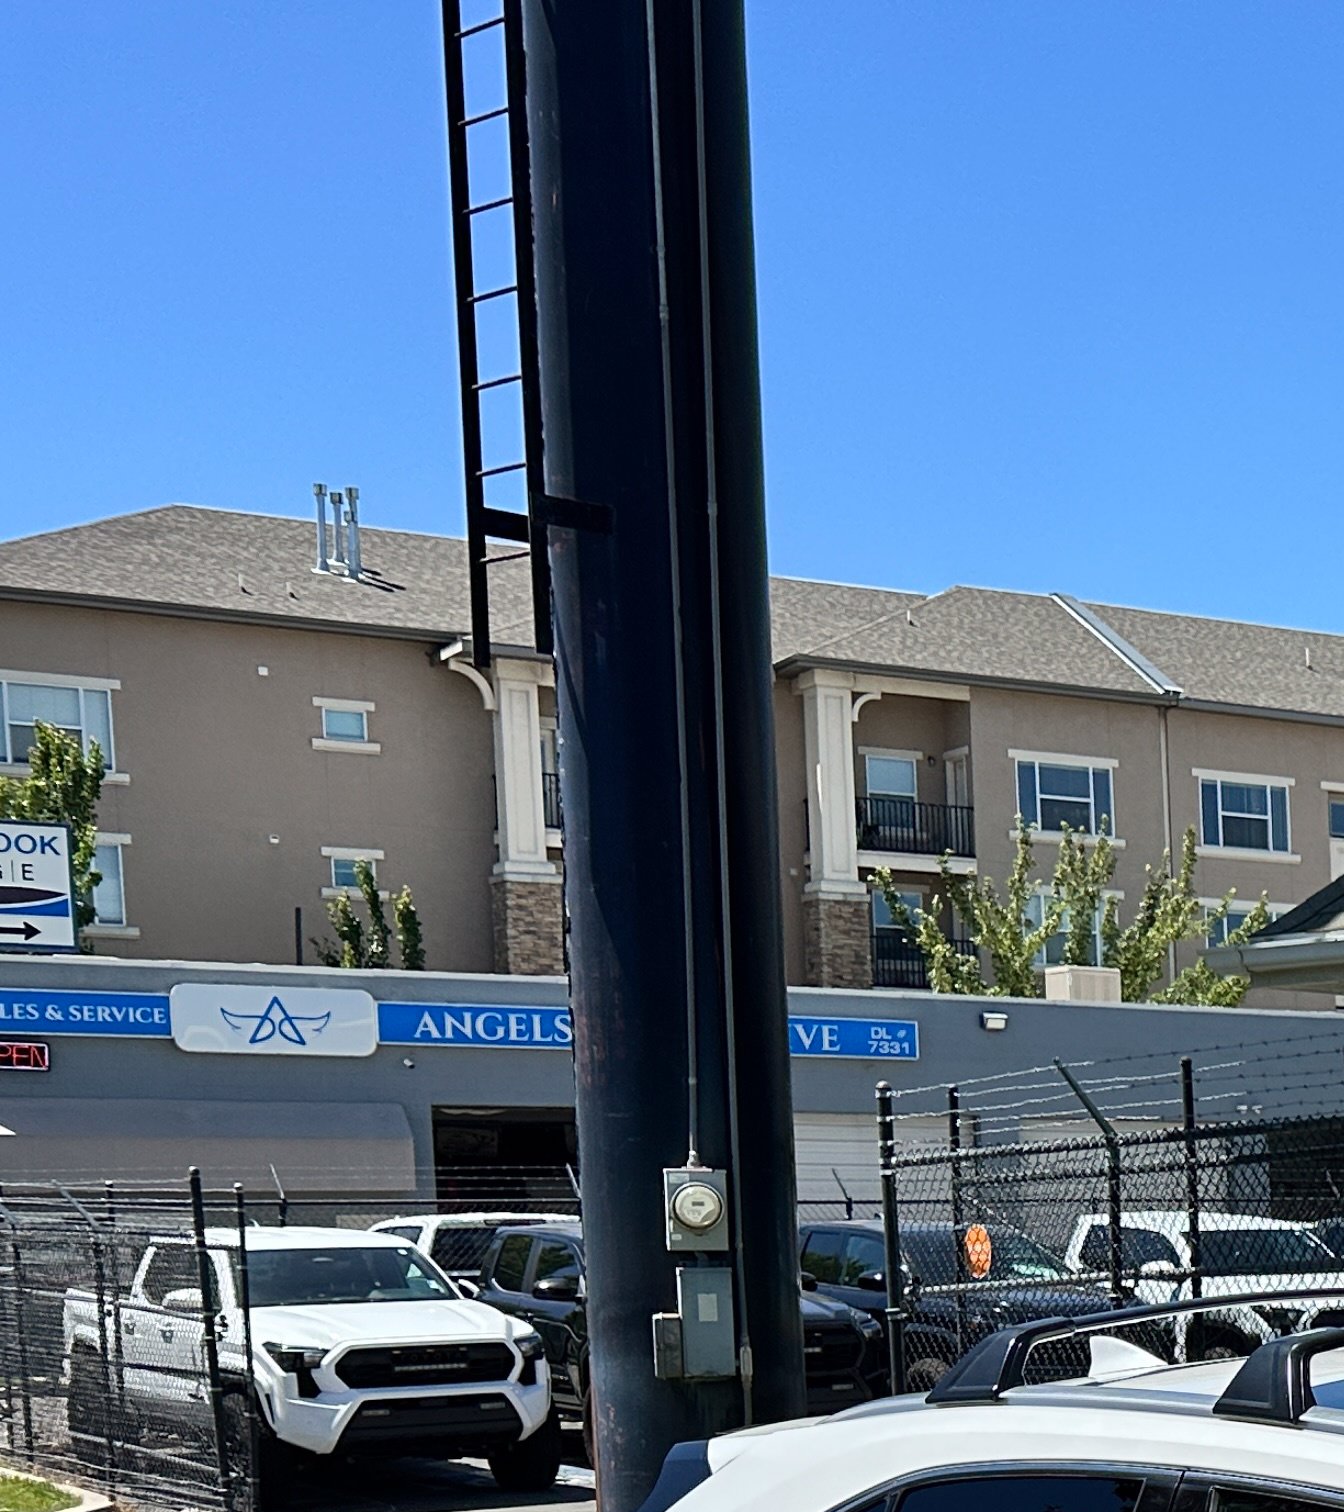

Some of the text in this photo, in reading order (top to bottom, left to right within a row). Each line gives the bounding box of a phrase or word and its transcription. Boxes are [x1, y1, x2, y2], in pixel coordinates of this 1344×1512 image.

[45, 1005, 64, 1021] &
[68, 1005, 166, 1024] SERVICE
[413, 1010, 573, 1043] ANGELS
[871, 1026, 892, 1040] DL
[867, 1041, 910, 1054] 7331
